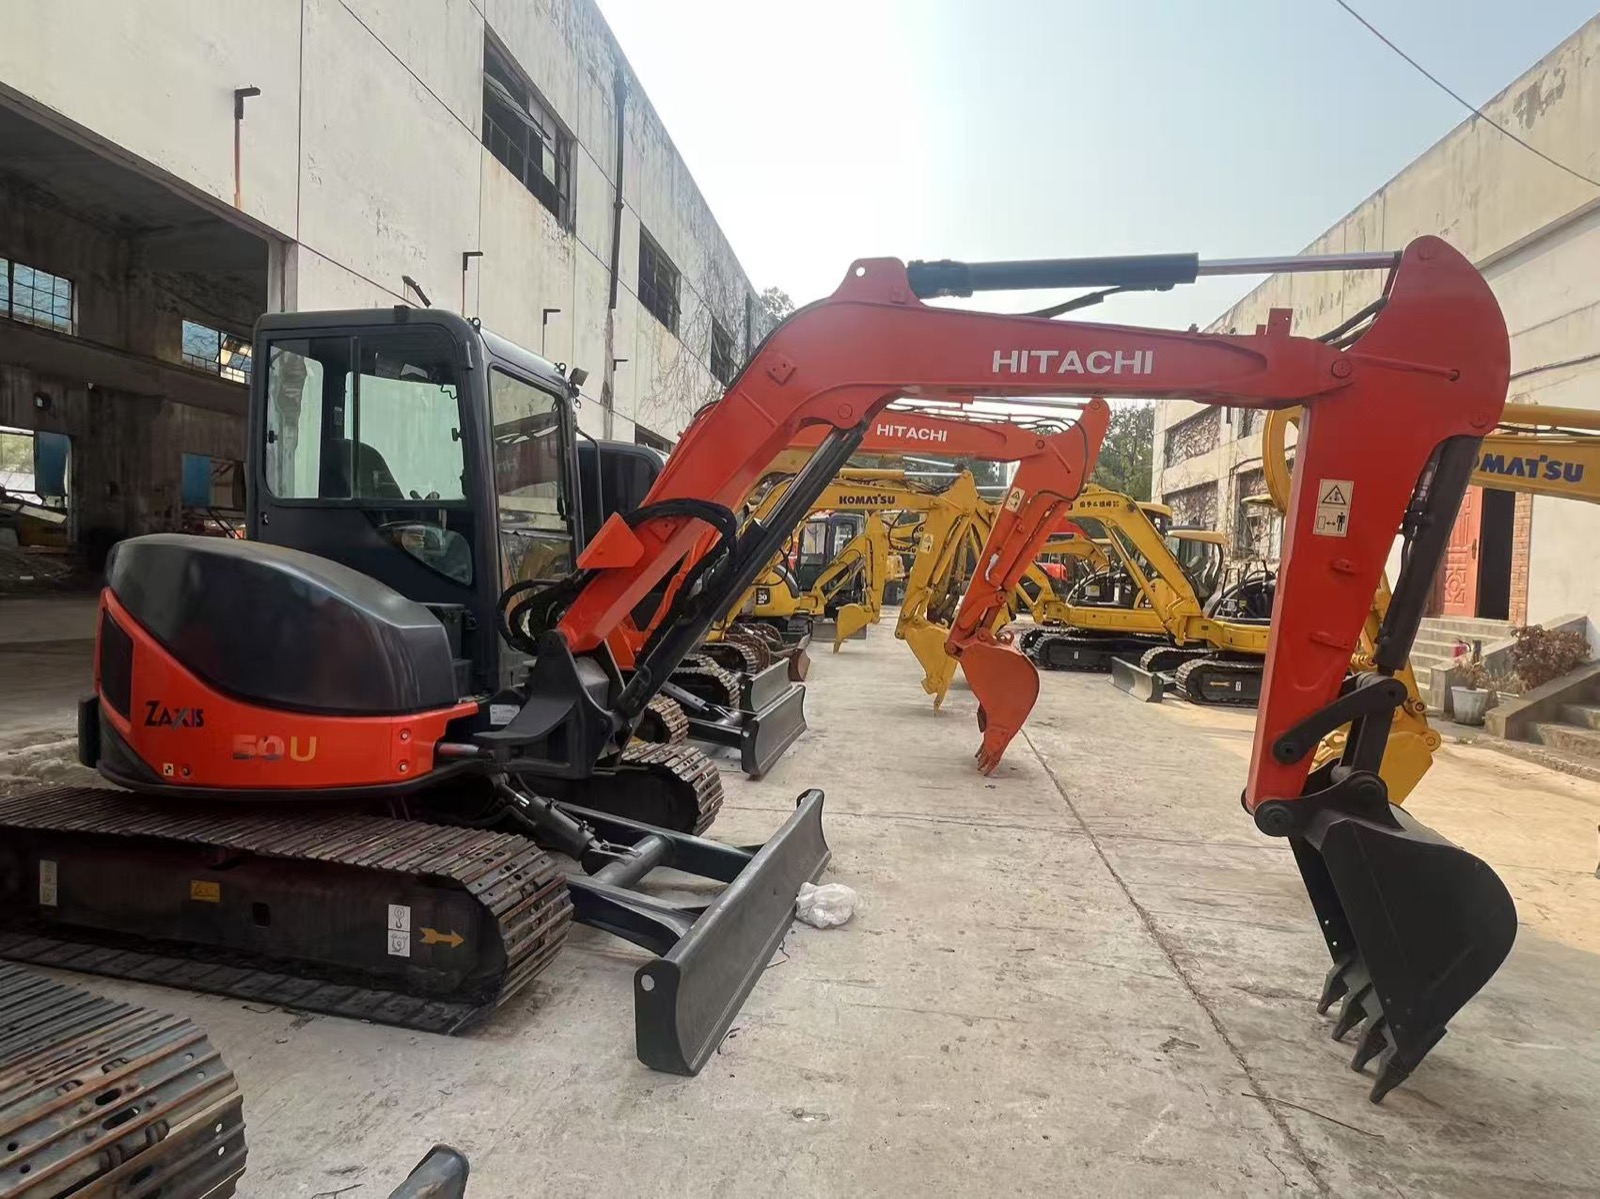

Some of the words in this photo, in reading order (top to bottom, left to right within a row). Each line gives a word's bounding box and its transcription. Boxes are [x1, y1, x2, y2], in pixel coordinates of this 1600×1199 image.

[992, 350, 1154, 375] HITACHI
[876, 423, 948, 442] HITACHI
[1474, 453, 1584, 483] MATSU
[838, 493, 896, 505] KOMATSU
[144, 700, 204, 729] ZAXIS
